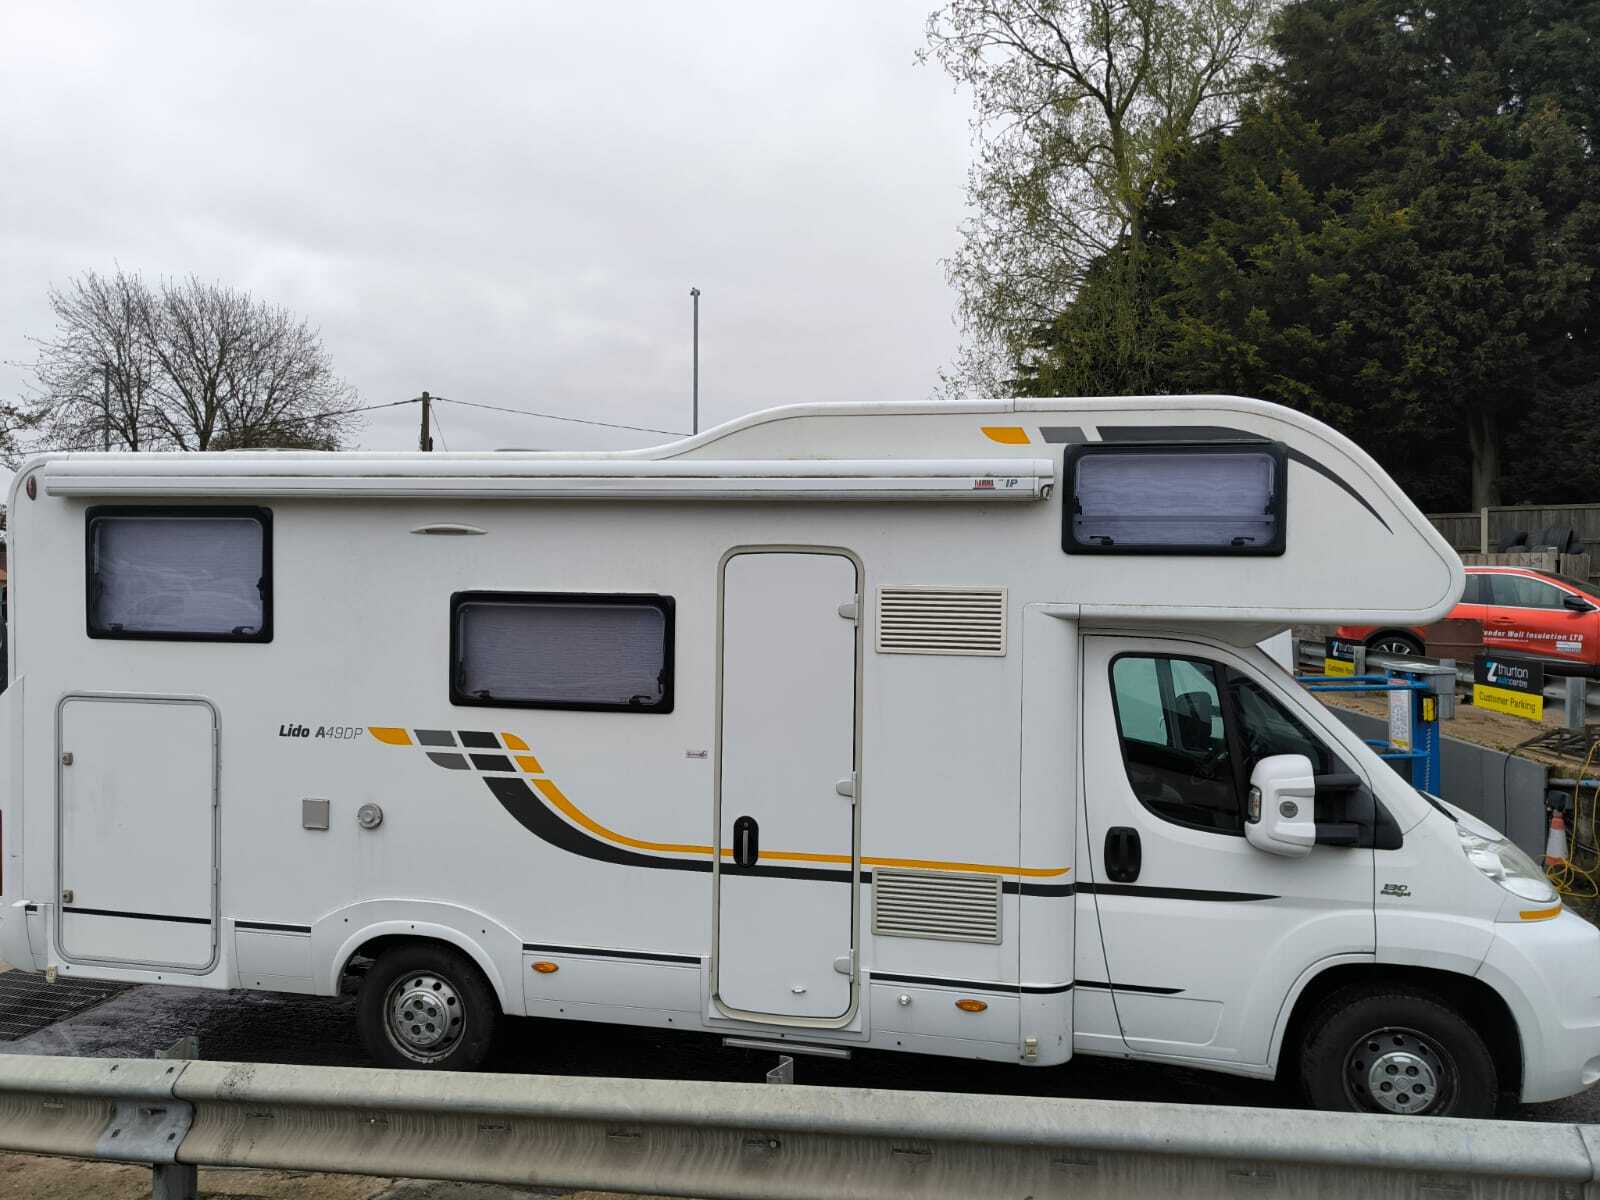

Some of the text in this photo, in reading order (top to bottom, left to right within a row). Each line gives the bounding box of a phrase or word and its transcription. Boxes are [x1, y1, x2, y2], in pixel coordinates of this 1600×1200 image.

[1526, 631, 1567, 641] Insulation
[1569, 633, 1584, 641] LTD
[1498, 663, 1529, 679] thurton
[1480, 690, 1536, 713] Customer Parking
[279, 723, 364, 740] Lido A49DP
